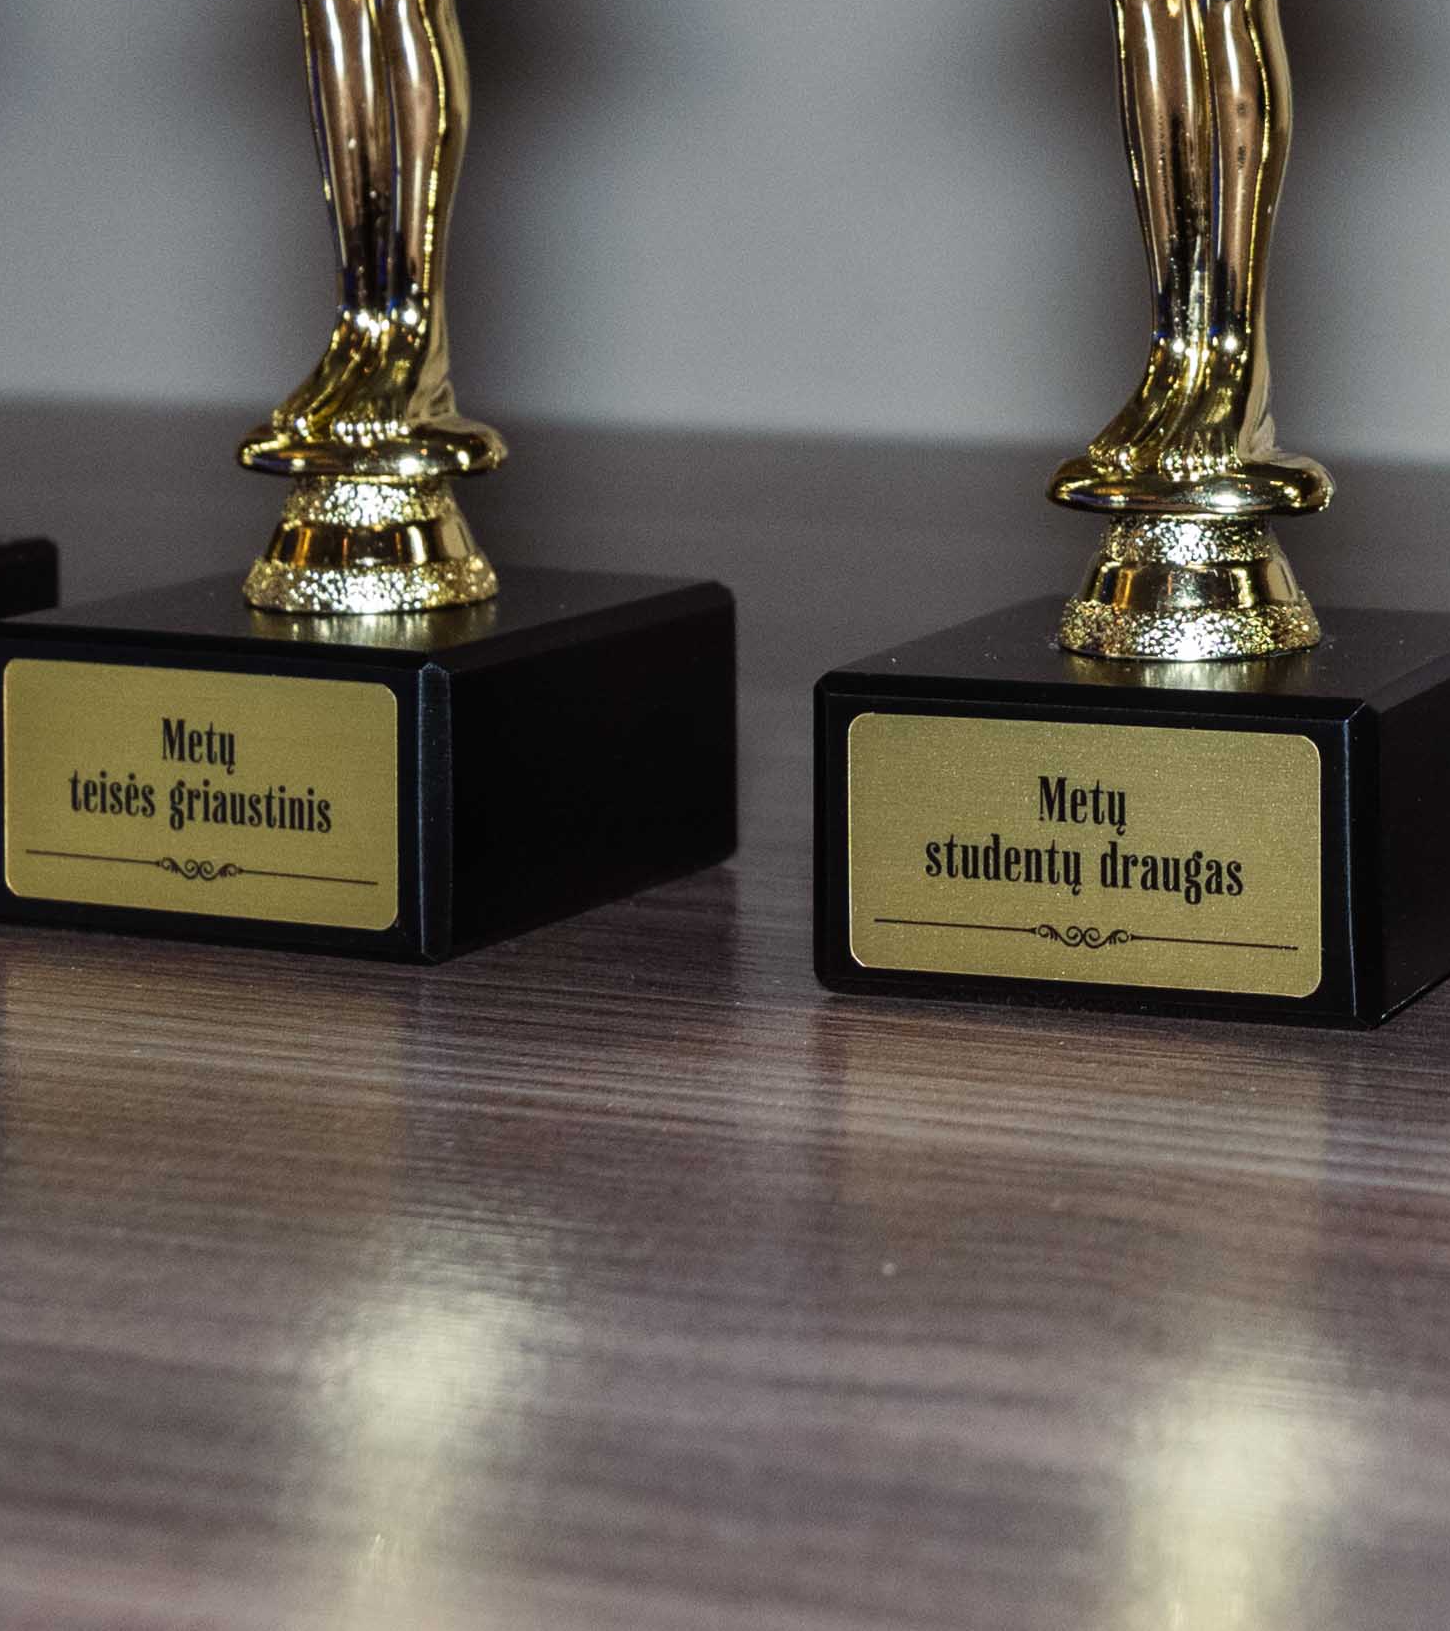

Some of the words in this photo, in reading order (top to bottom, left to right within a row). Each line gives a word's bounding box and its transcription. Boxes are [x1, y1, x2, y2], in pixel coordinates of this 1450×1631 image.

[162, 718, 235, 774] Metų
[70, 770, 155, 817] teisės
[169, 779, 332, 833] griaustinis
[1038, 775, 1127, 835] Metų
[926, 834, 1082, 895] studentų
[1100, 841, 1244, 904] draugas
